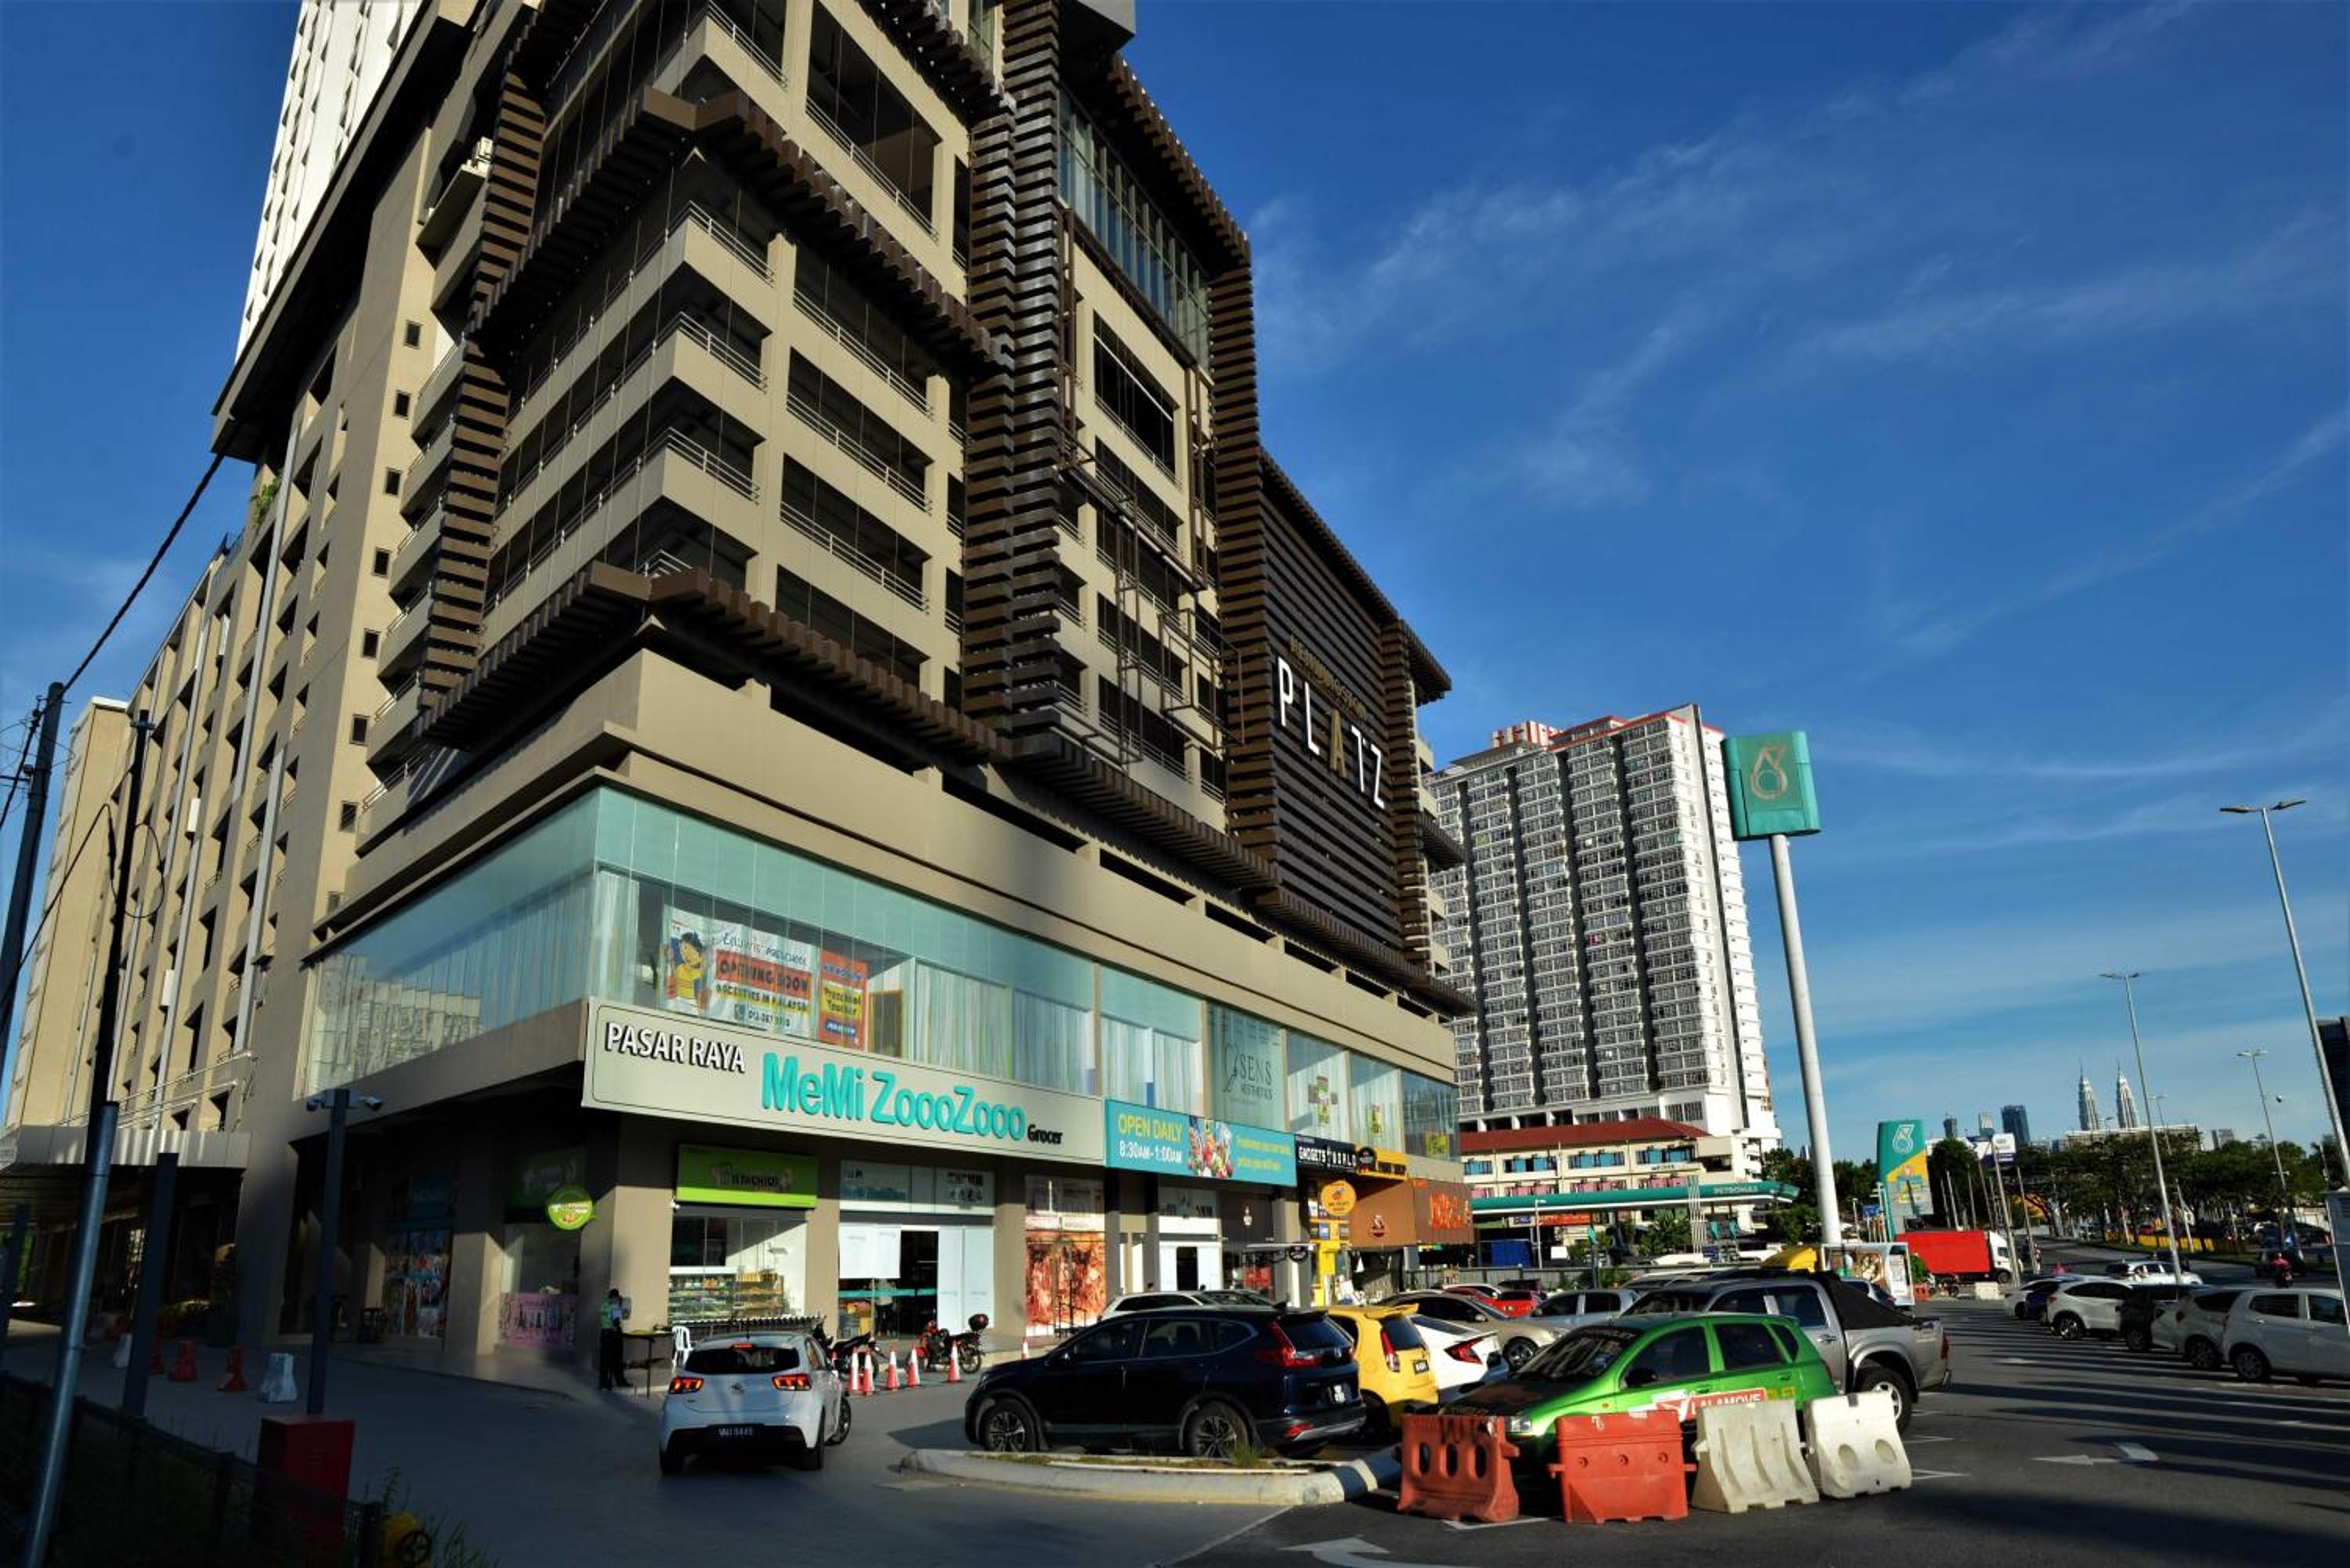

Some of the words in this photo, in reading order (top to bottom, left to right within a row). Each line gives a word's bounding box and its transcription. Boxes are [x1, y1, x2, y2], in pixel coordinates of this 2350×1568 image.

[606, 1021, 685, 1064] PASAR
[691, 1038, 745, 1073] RAYA
[1238, 1053, 1273, 1086] SENS
[762, 1053, 865, 1121] MeMi
[870, 1071, 1026, 1141] ZoooZooo
[1117, 1112, 1151, 1139] OPEN
[1153, 1118, 1183, 1143] DAILY
